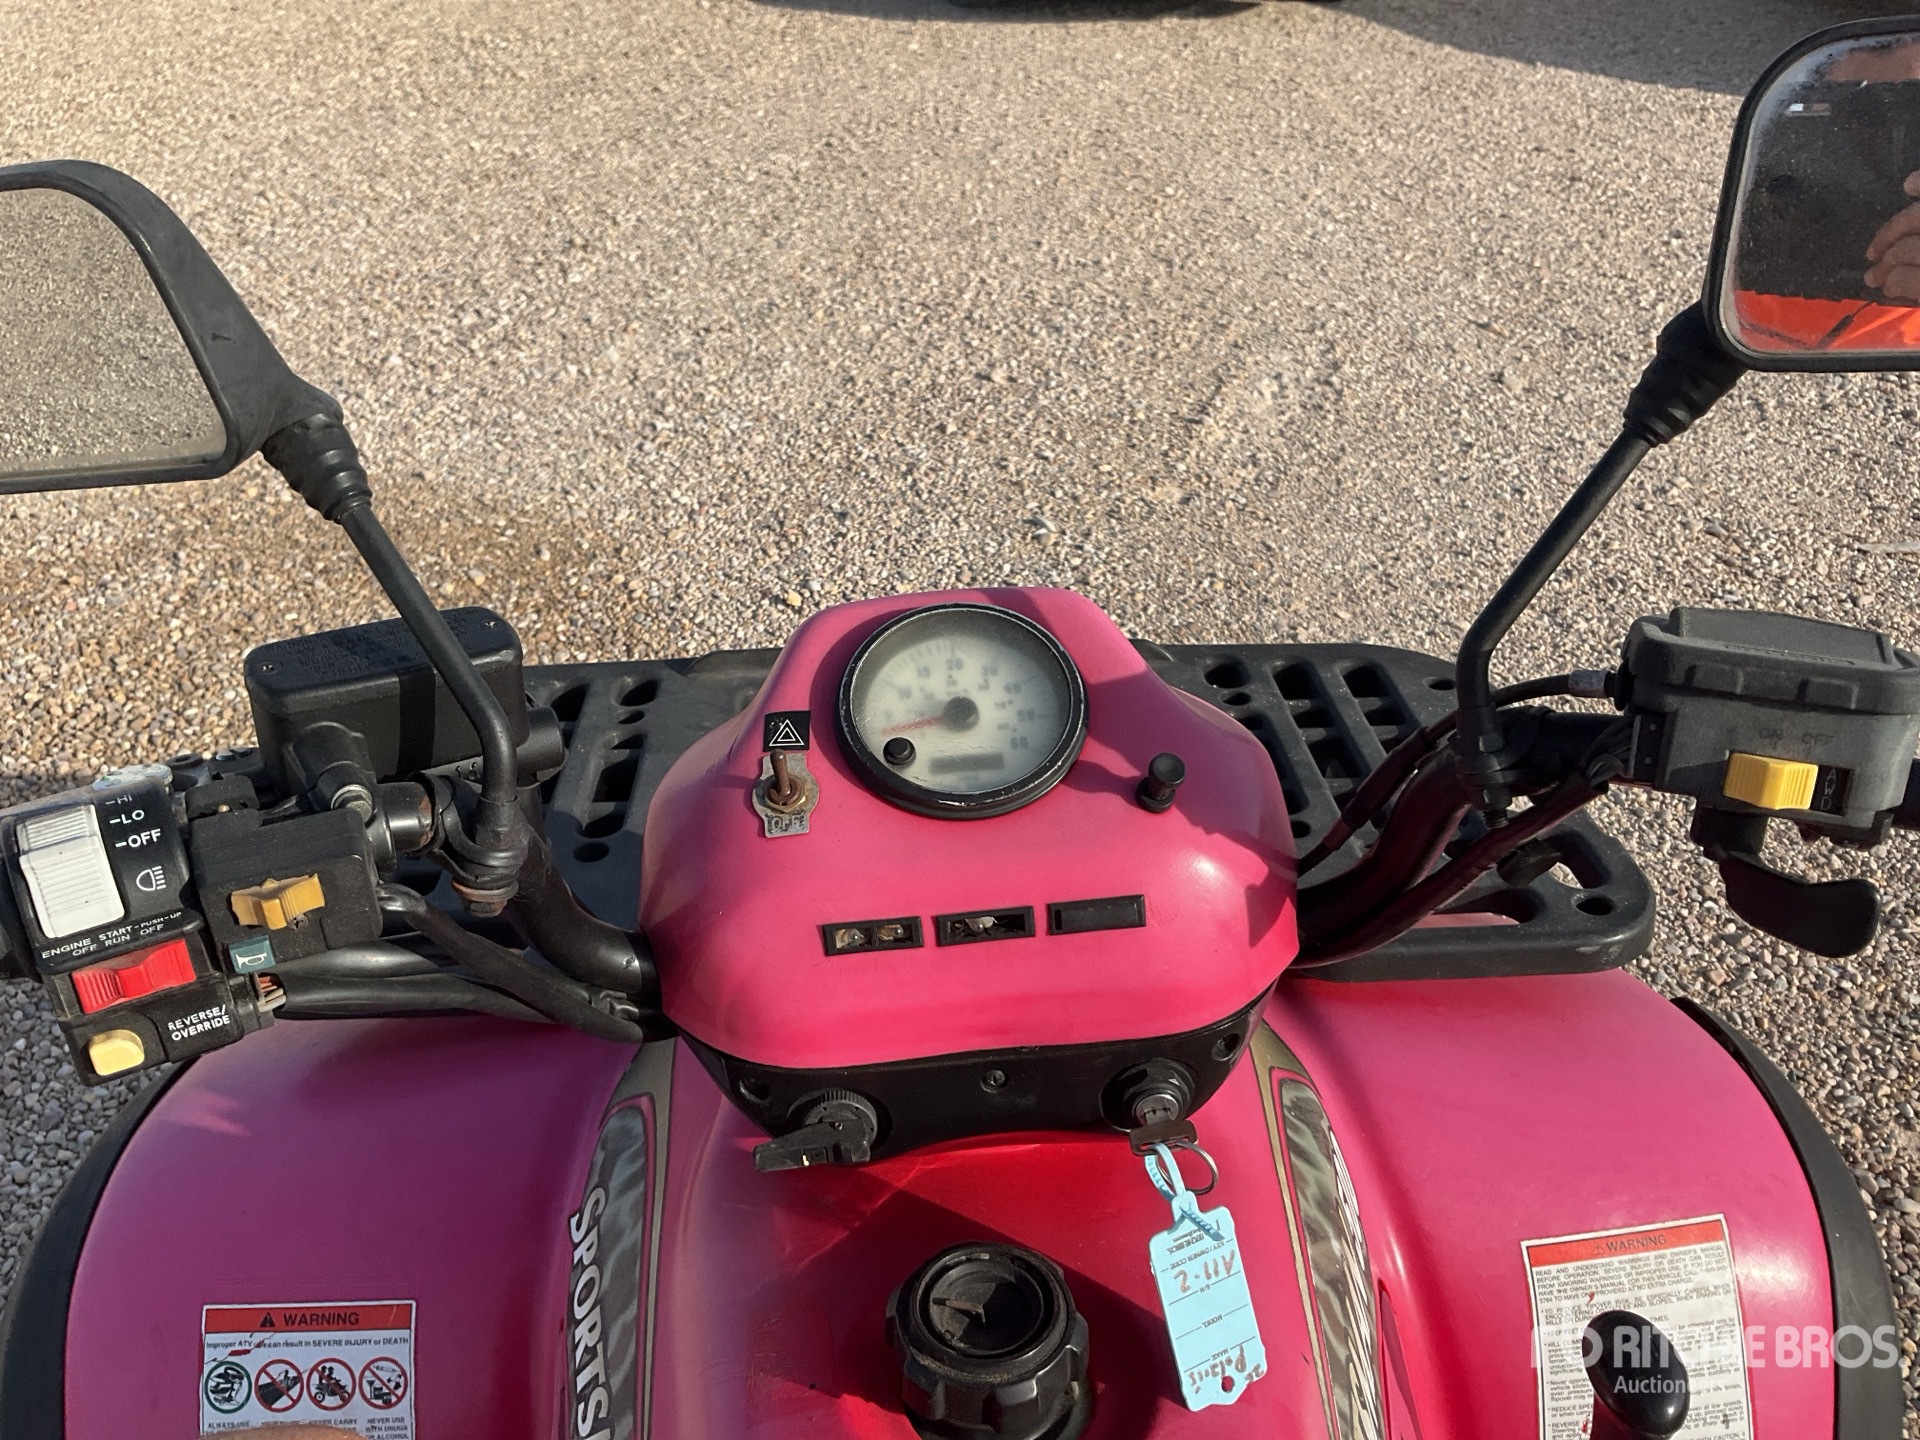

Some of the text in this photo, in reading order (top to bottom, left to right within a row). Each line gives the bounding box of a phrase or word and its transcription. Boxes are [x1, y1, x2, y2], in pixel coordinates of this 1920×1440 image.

[41, 937, 92, 959] ENGINE
[72, 923, 165, 957] OFF RUN OFF
[167, 1003, 226, 1031] REVERSE/
[171, 1014, 231, 1041] OVERRIDE
[1606, 1234, 1667, 1252] WARNING
[1535, 1269, 1552, 1277] READ
[1556, 1266, 1570, 1274] AND
[1573, 1261, 1614, 1272] UNDERSTAND
[1536, 1275, 1561, 1283] BEFORE
[1604, 1266, 1627, 1274] SEVERE
[1538, 1282, 1556, 1290] FROM
[1557, 1278, 1588, 1287] IGNORING
[1590, 1273, 1622, 1283] WARNINGS
[1600, 1280, 1626, 1289] MANUAL
[1596, 1287, 1627, 1296] PROVIDED
[283, 1311, 360, 1327] WARNING
[304, 1339, 311, 1347] in
[312, 1339, 343, 1347] SEVERE
[344, 1338, 374, 1346] INJURY
[382, 1337, 409, 1345] DEATH
[1211, 1347, 1229, 1361] MAKE
[207, 1421, 235, 1429] ALWAYS
